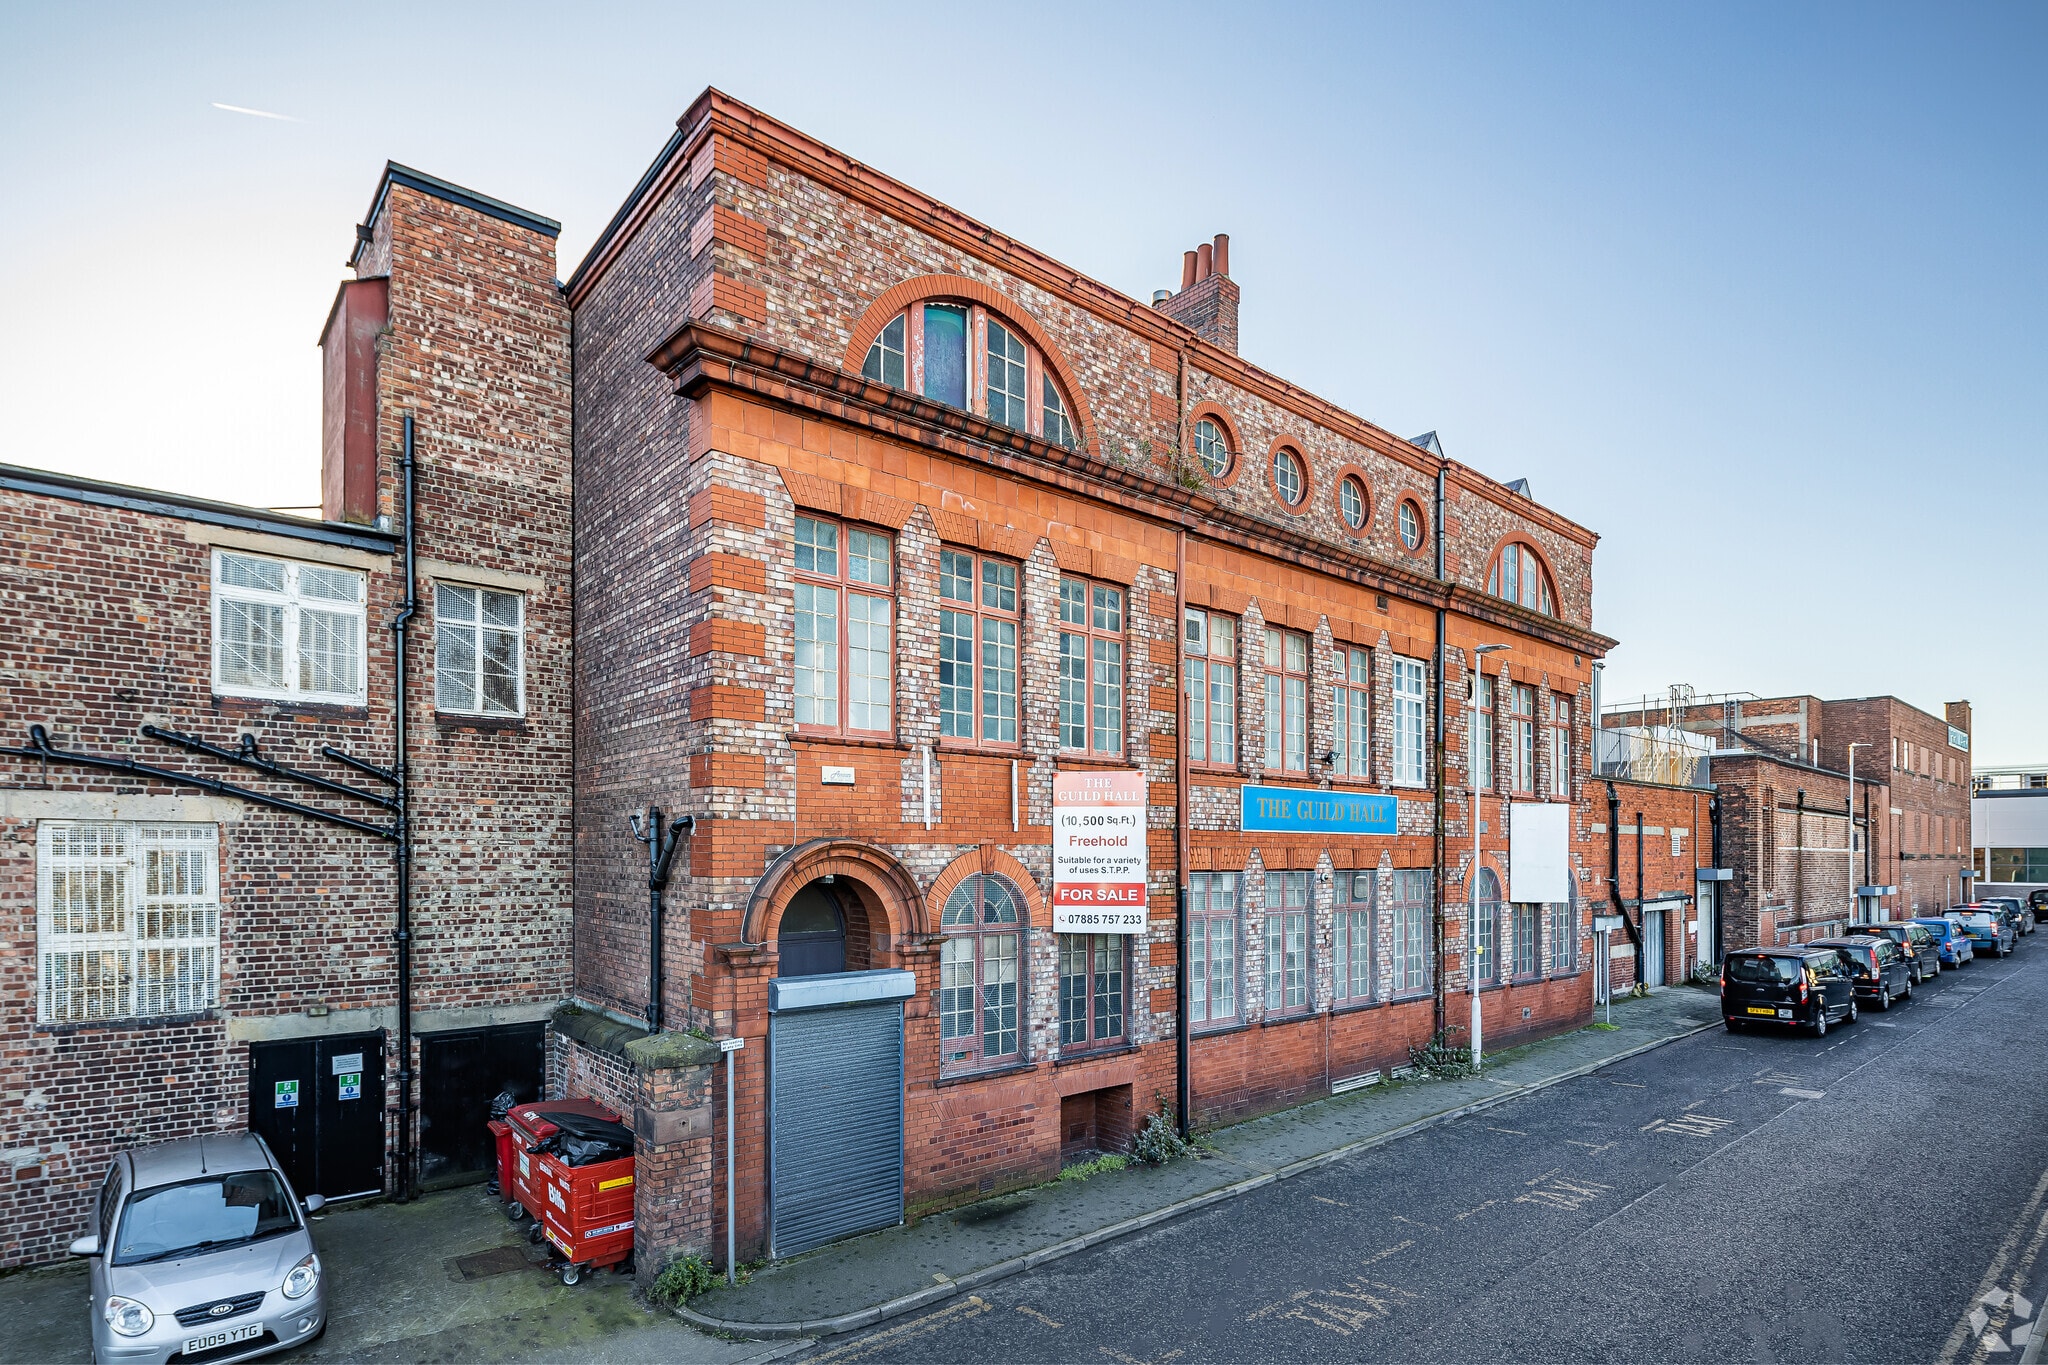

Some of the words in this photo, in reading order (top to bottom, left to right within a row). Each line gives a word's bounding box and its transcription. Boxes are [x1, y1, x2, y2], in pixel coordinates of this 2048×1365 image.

[1084, 778, 1112, 788] THE
[1058, 791, 1101, 802] GUILD
[1104, 791, 1140, 801] HALL
[1256, 797, 1292, 819] THE
[1297, 800, 1345, 821] GUILD
[1349, 803, 1387, 823] HALL
[1069, 835, 1128, 847] Freehold
[1057, 856, 1091, 864] Suitable
[1094, 856, 1105, 864] for
[1113, 857, 1142, 866] variety
[1069, 866, 1078, 874] of
[1100, 866, 1130, 874] S.T.P.P.
[1060, 888, 1094, 901] FOR
[1097, 889, 1138, 901] SALE
[1068, 915, 1100, 925] 07885
[1102, 915, 1121, 925] 757
[1123, 915, 1142, 925] 233
[213, 1306, 230, 1314] KIA
[188, 1334, 227, 1351] EU09
[230, 1325, 258, 1341] YTG
